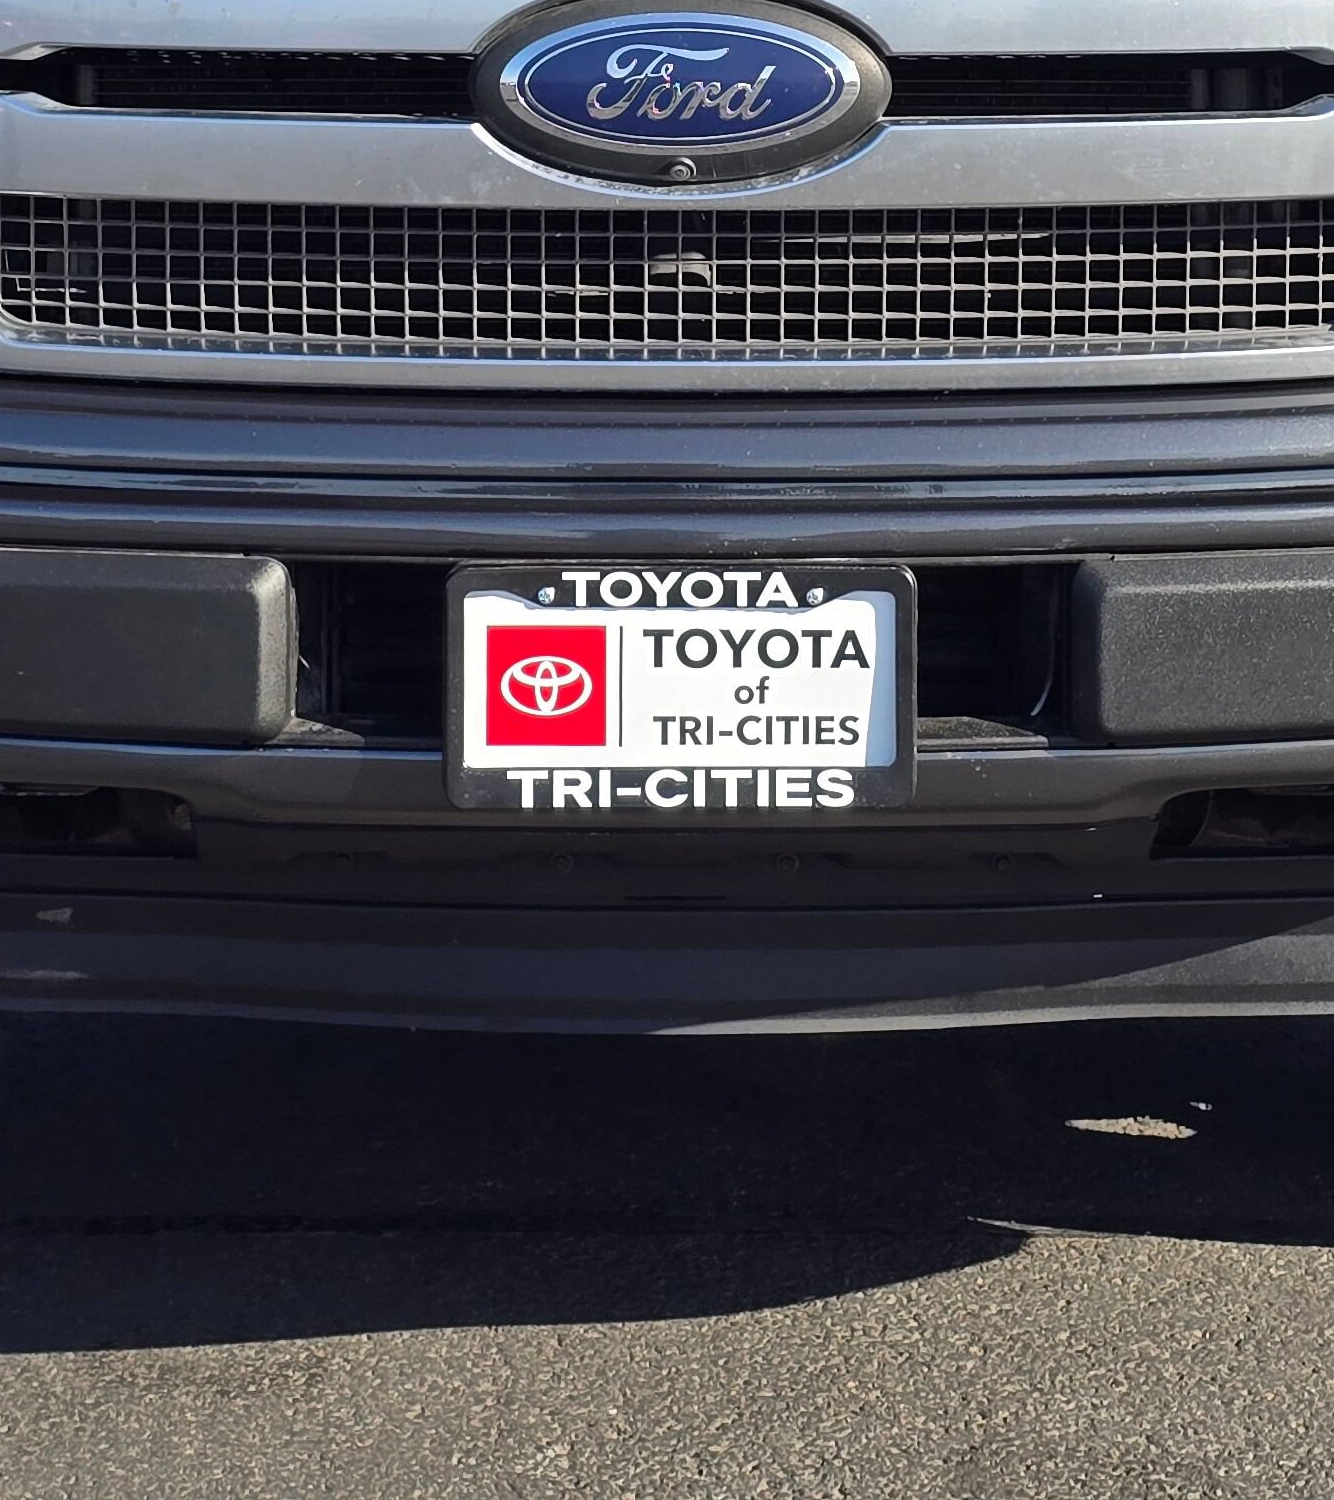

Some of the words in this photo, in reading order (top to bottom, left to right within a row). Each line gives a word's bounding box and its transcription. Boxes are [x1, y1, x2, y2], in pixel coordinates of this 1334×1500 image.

[585, 43, 777, 121] Ford
[561, 571, 799, 608] TOYOTA
[642, 628, 871, 669] TOYOTA
[733, 676, 770, 705] of
[652, 715, 860, 746] TRI-CITIES
[506, 768, 856, 809] TRI-CITIES
